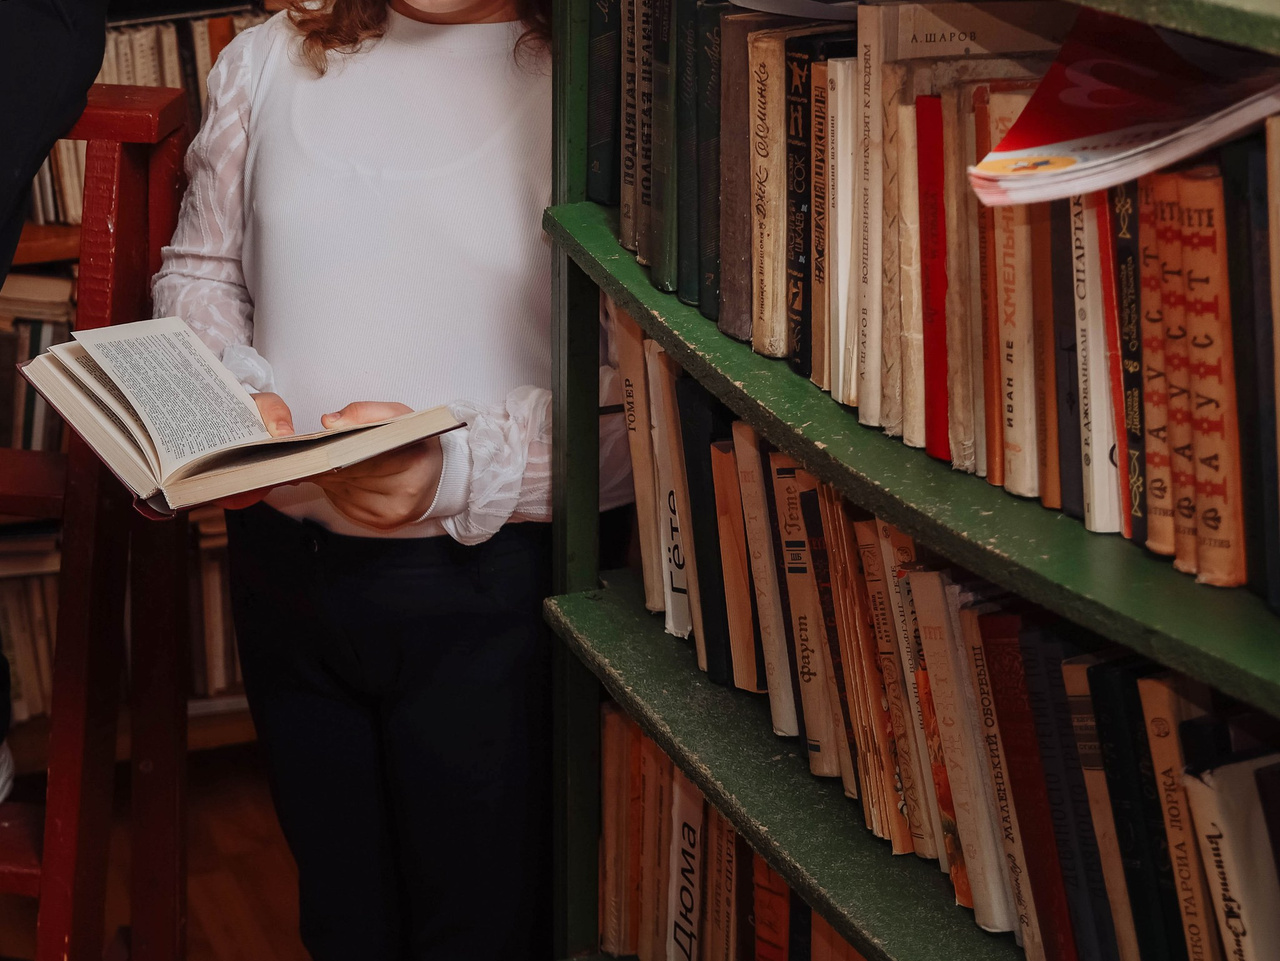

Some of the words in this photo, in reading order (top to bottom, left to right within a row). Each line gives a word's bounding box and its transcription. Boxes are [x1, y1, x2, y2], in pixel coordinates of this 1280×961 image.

[862, 43, 871, 98] ЛЮДЯМ
[621, 70, 640, 186] ПОДНЯТАЯ
[811, 85, 828, 180] ШУКШИН
[862, 100, 870, 108] К
[636, 90, 655, 205] ПОДНЯТАЯ
[829, 114, 837, 160] ШУКШИН
[862, 112, 870, 181] ПРИХОДЯТ
[791, 154, 806, 193] СОК
[828, 163, 836, 208] ВАСИЛИЙ
[785, 198, 796, 259] ВАСИЛИЙ
[860, 186, 869, 284] ВОЛШЕБНИКИ
[1071, 193, 1087, 299] СПАРТАК
[1125, 255, 1135, 299] Твиста
[1005, 339, 1014, 363] ЛЕ
[1126, 303, 1138, 351] Оливера
[1005, 376, 1014, 427] ИВАН
[1078, 327, 1092, 432] ДЖОВАНЬОЛИ
[1143, 245, 1168, 500] ФАУСТ
[1161, 261, 1196, 520] ФАУСТ
[1187, 268, 1222, 530] ФАУСТ
[621, 376, 639, 432] ГОМЕР
[1124, 390, 1133, 430] Чарльз
[1130, 387, 1141, 436] Диккенс
[1082, 436, 1090, 447] Р.
[664, 489, 688, 595] Гёте
[870, 593, 878, 612] ДОЙЛ
[889, 564, 900, 594] ГЕТЕ
[882, 626, 891, 643] СЭР
[896, 598, 915, 674] ВОЛЬФГАНГ
[972, 644, 995, 728] ОБОРВЫШ
[985, 731, 1014, 844] МАЛЕНЬКИЙ
[1160, 768, 1183, 832] ЛОРКА
[659, 819, 712, 961] Дюма
[709, 878, 726, 930] ДАНТЕ
[1006, 851, 1028, 912] Гринвуд
[1173, 840, 1197, 919] ГАРСИА
[1018, 913, 1029, 927] Д.
